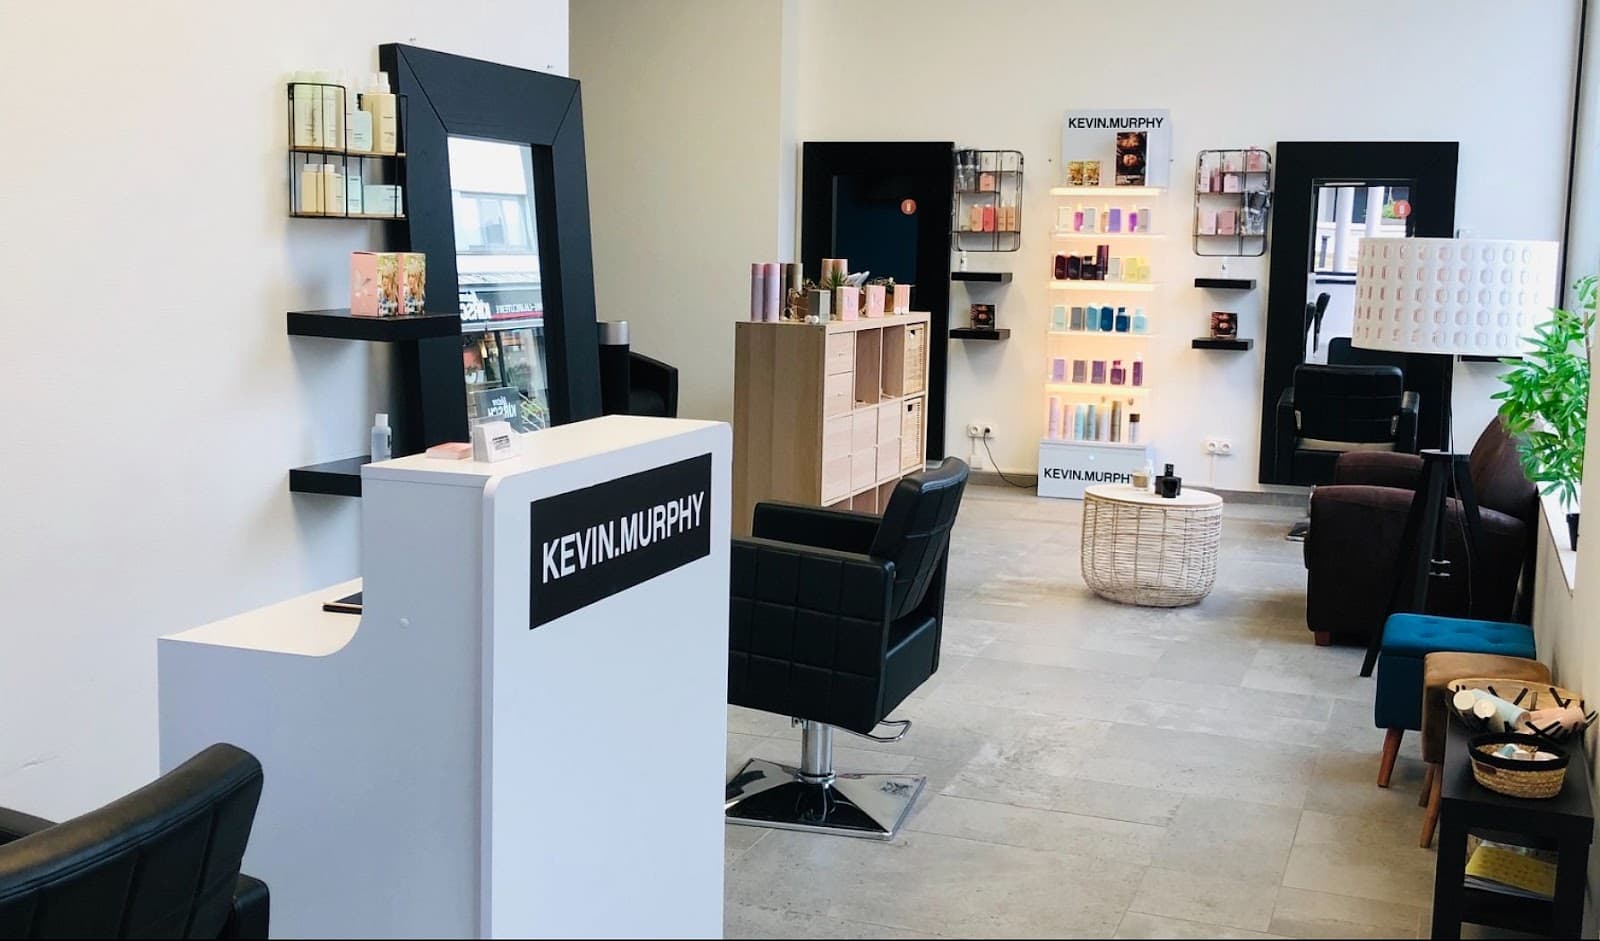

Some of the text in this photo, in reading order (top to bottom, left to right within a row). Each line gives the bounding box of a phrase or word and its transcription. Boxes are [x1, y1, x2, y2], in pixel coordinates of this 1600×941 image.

[1068, 117, 1164, 129] KEVIN.MURPHY
[1043, 468, 1133, 484] KEVIN.MURPH
[542, 491, 705, 584] KEVIN.MURPHY
